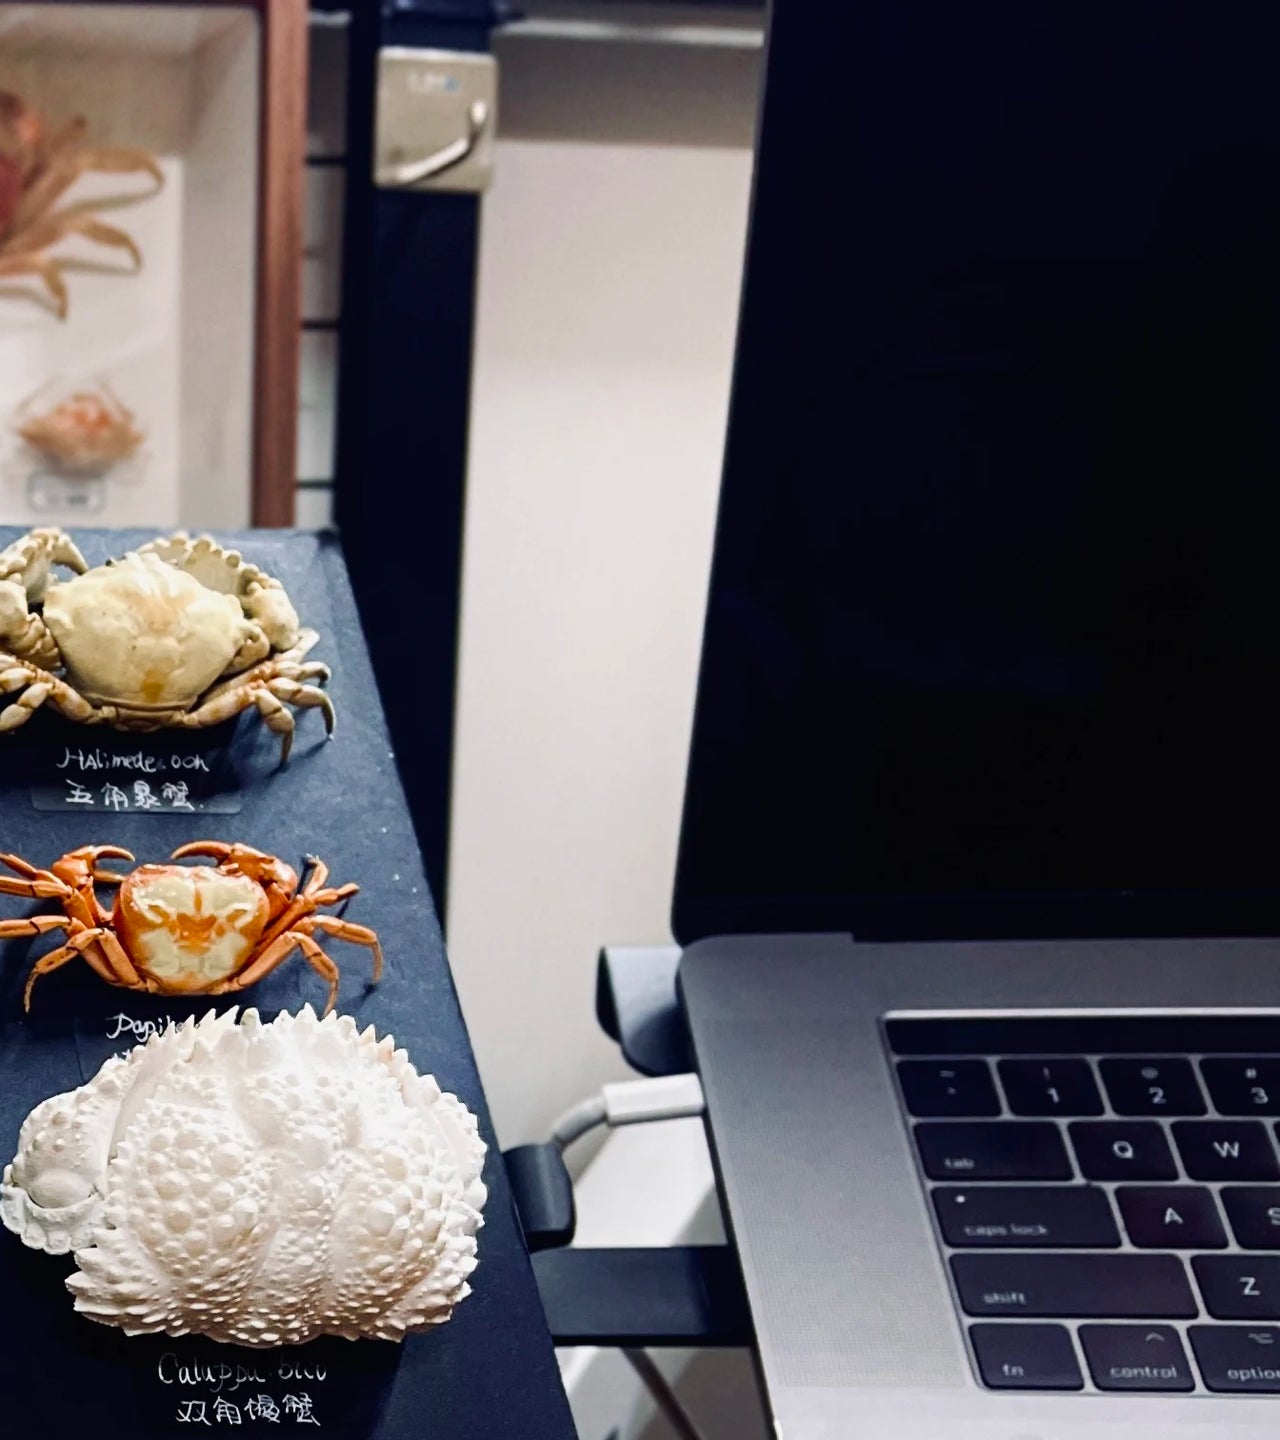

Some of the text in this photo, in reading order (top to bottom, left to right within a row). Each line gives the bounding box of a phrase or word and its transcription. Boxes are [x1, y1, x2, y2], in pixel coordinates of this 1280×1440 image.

[1149, 1087, 1166, 1104] 2
[1251, 1087, 1269, 1104] 3
[1113, 1141, 1134, 1159] Q
[1214, 1141, 1240, 1158] W
[1165, 1208, 1184, 1226] A
[1241, 1278, 1260, 1295] Z
[1110, 1365, 1178, 1379] control
